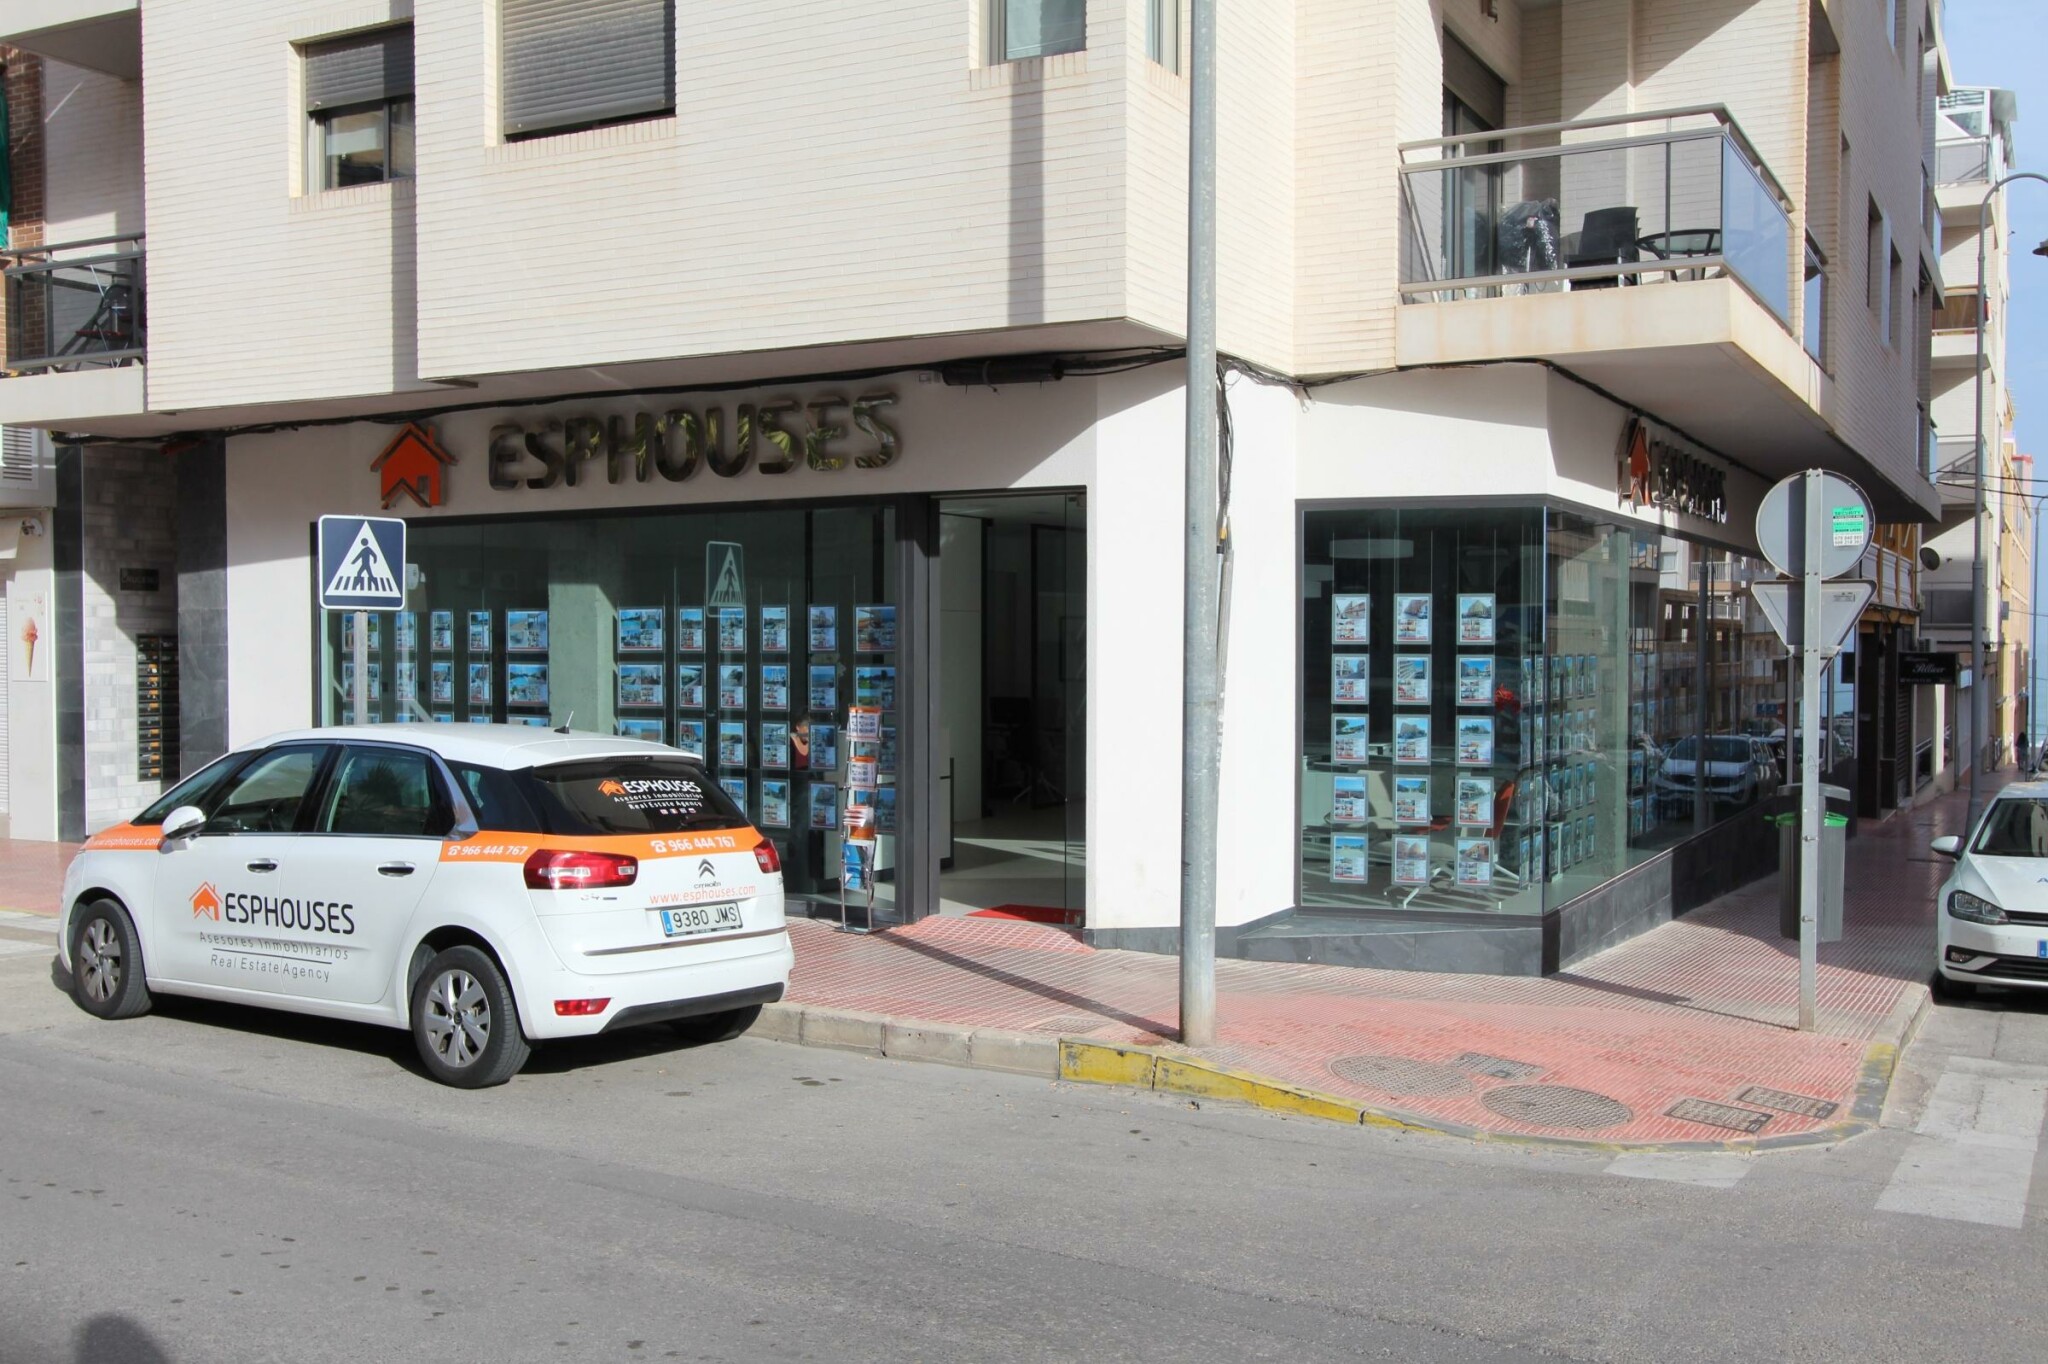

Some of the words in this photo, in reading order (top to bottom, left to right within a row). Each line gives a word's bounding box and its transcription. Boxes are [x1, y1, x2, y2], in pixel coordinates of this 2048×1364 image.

[488, 392, 900, 491] ESPHOUSES
[622, 779, 702, 793] ESPHOUSES
[613, 793, 652, 803] Asesores
[461, 845, 481, 856] 966
[482, 845, 503, 855] 444
[506, 845, 529, 856] 767
[667, 838, 693, 852] 966
[694, 837, 717, 849] 444
[716, 836, 737, 848] 767
[650, 884, 757, 905] www.esphouses.com
[225, 892, 355, 935] ESPHOUSES
[672, 908, 709, 929] 9380
[714, 906, 738, 923] JMS
[199, 931, 254, 948] Asesores
[258, 939, 349, 960] Inmobiliarios
[210, 953, 237, 969] Real
[240, 956, 280, 974] Estate
[282, 963, 330, 983] Agency
